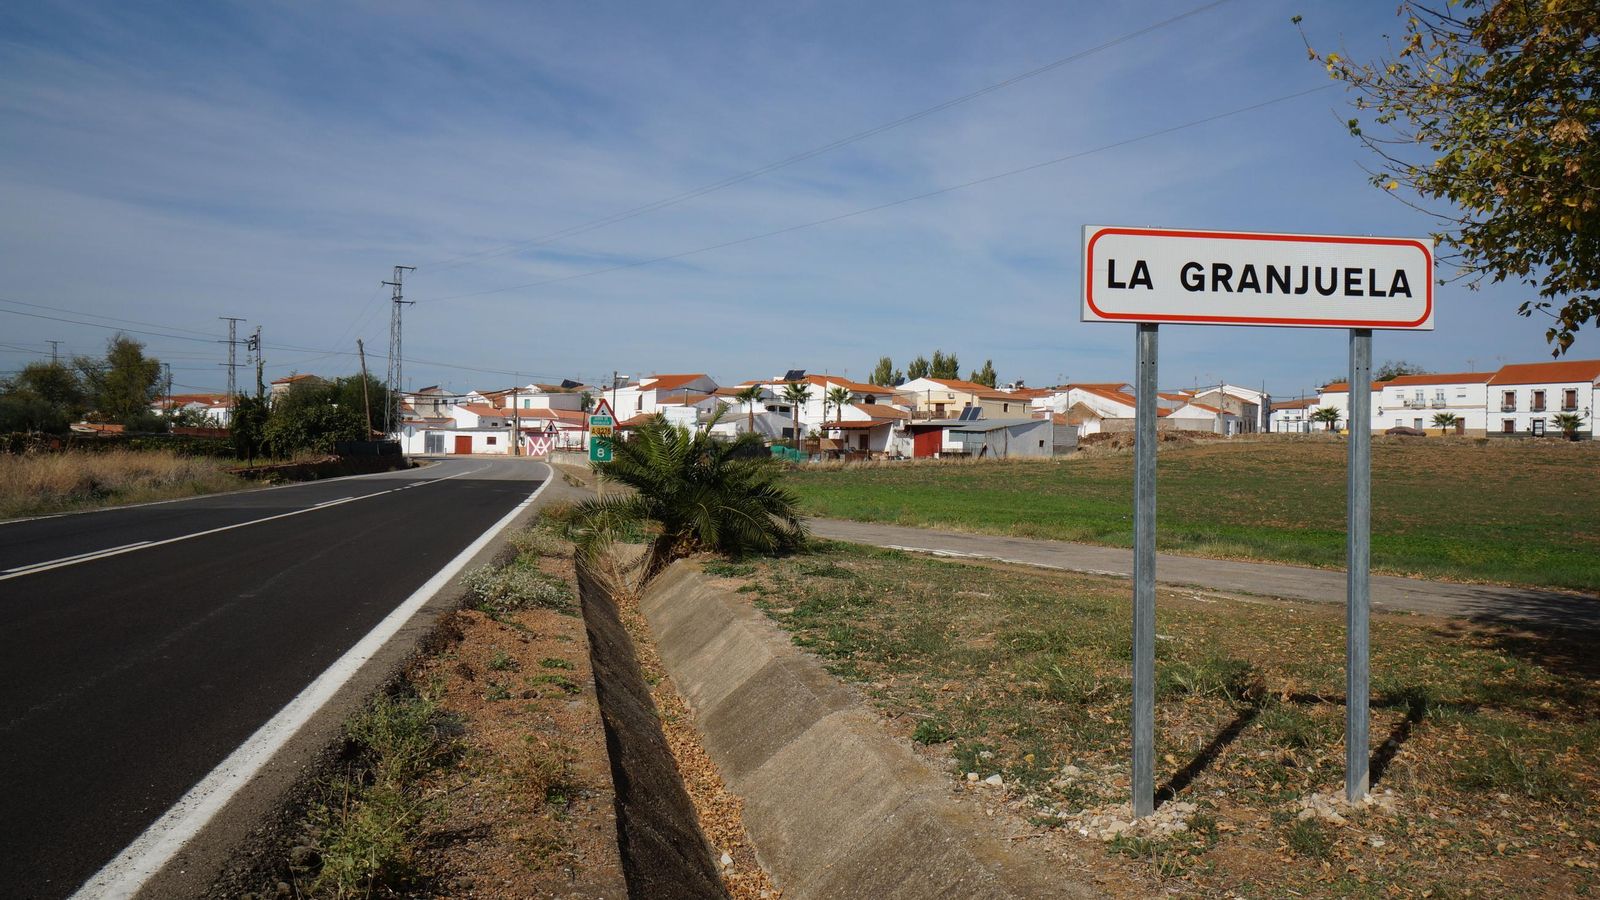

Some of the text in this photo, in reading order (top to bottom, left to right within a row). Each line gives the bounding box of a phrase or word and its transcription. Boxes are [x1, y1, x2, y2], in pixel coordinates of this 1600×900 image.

[1107, 259, 1413, 298] LA GRANJUELA
[597, 448, 605, 458] 8
